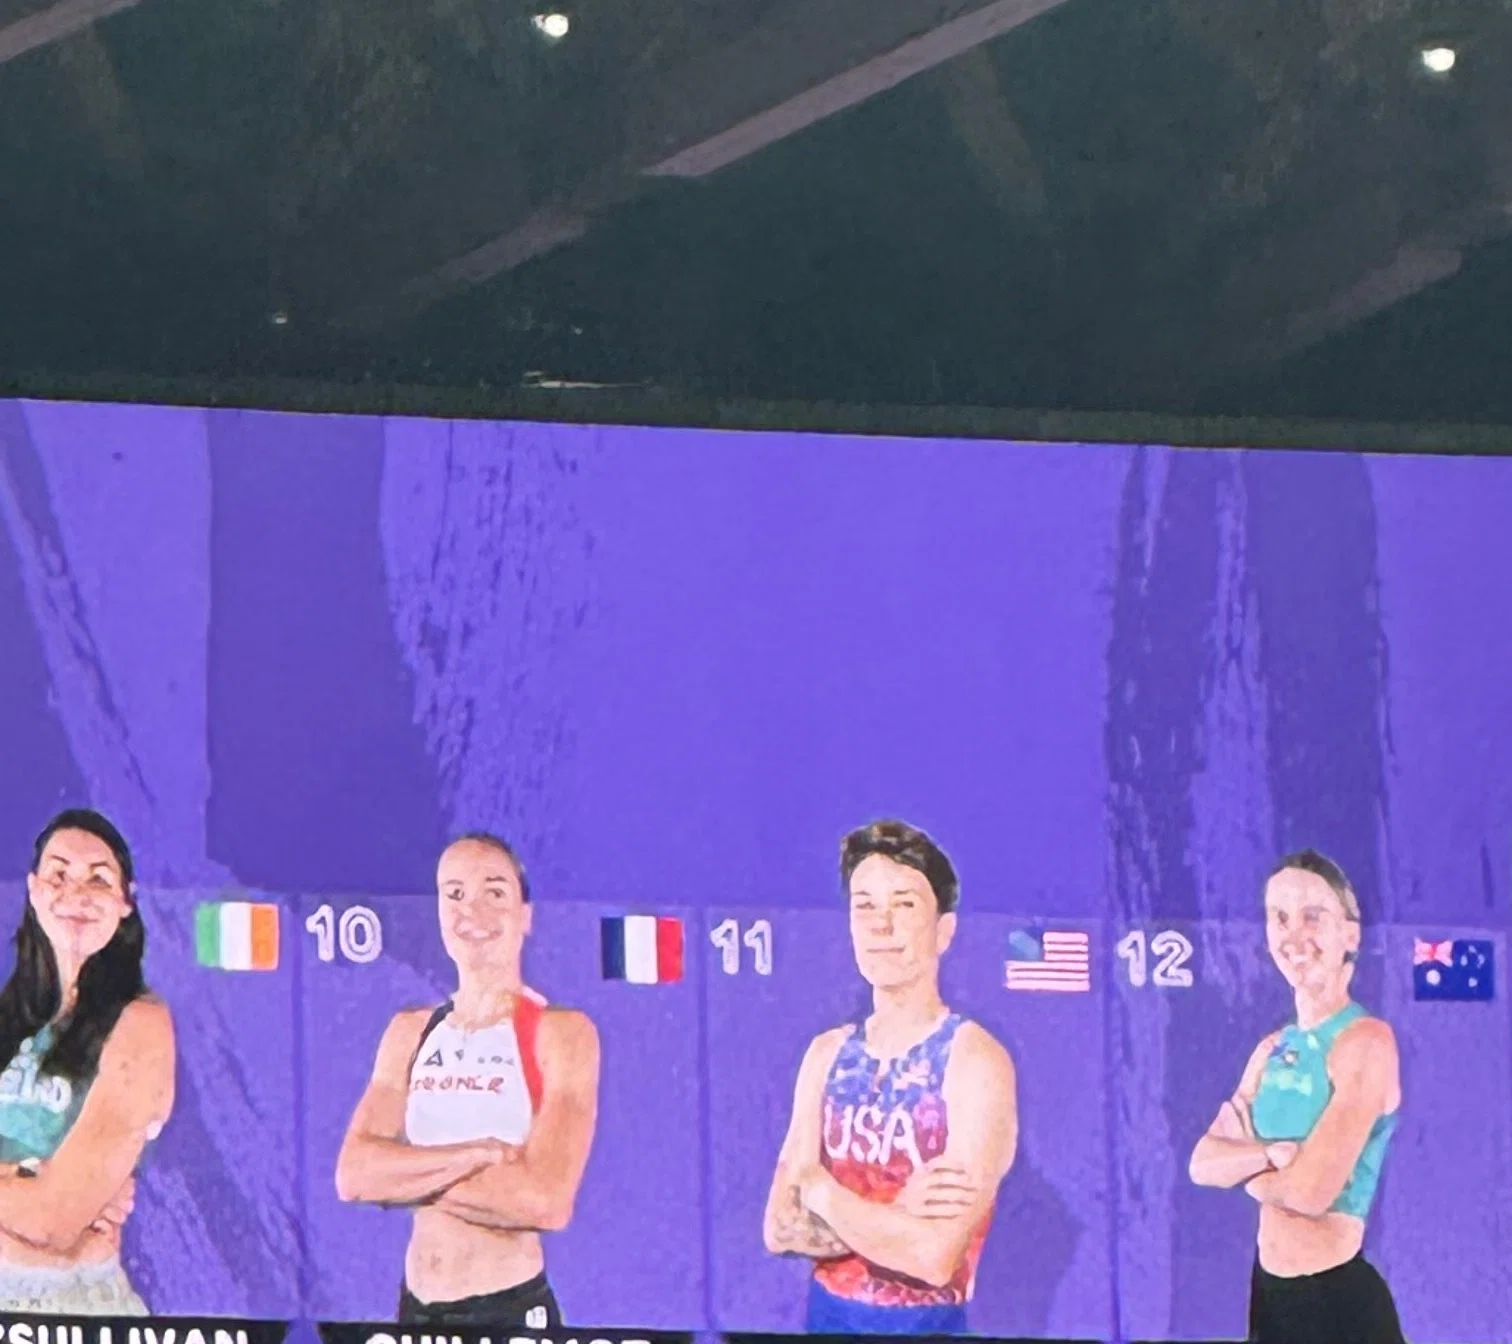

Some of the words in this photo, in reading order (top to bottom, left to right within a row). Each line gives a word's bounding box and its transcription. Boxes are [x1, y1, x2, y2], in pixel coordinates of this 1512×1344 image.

[305, 903, 383, 964] 10
[709, 918, 772, 975] 11
[1117, 930, 1194, 988] 12
[823, 1102, 924, 1170] USA
